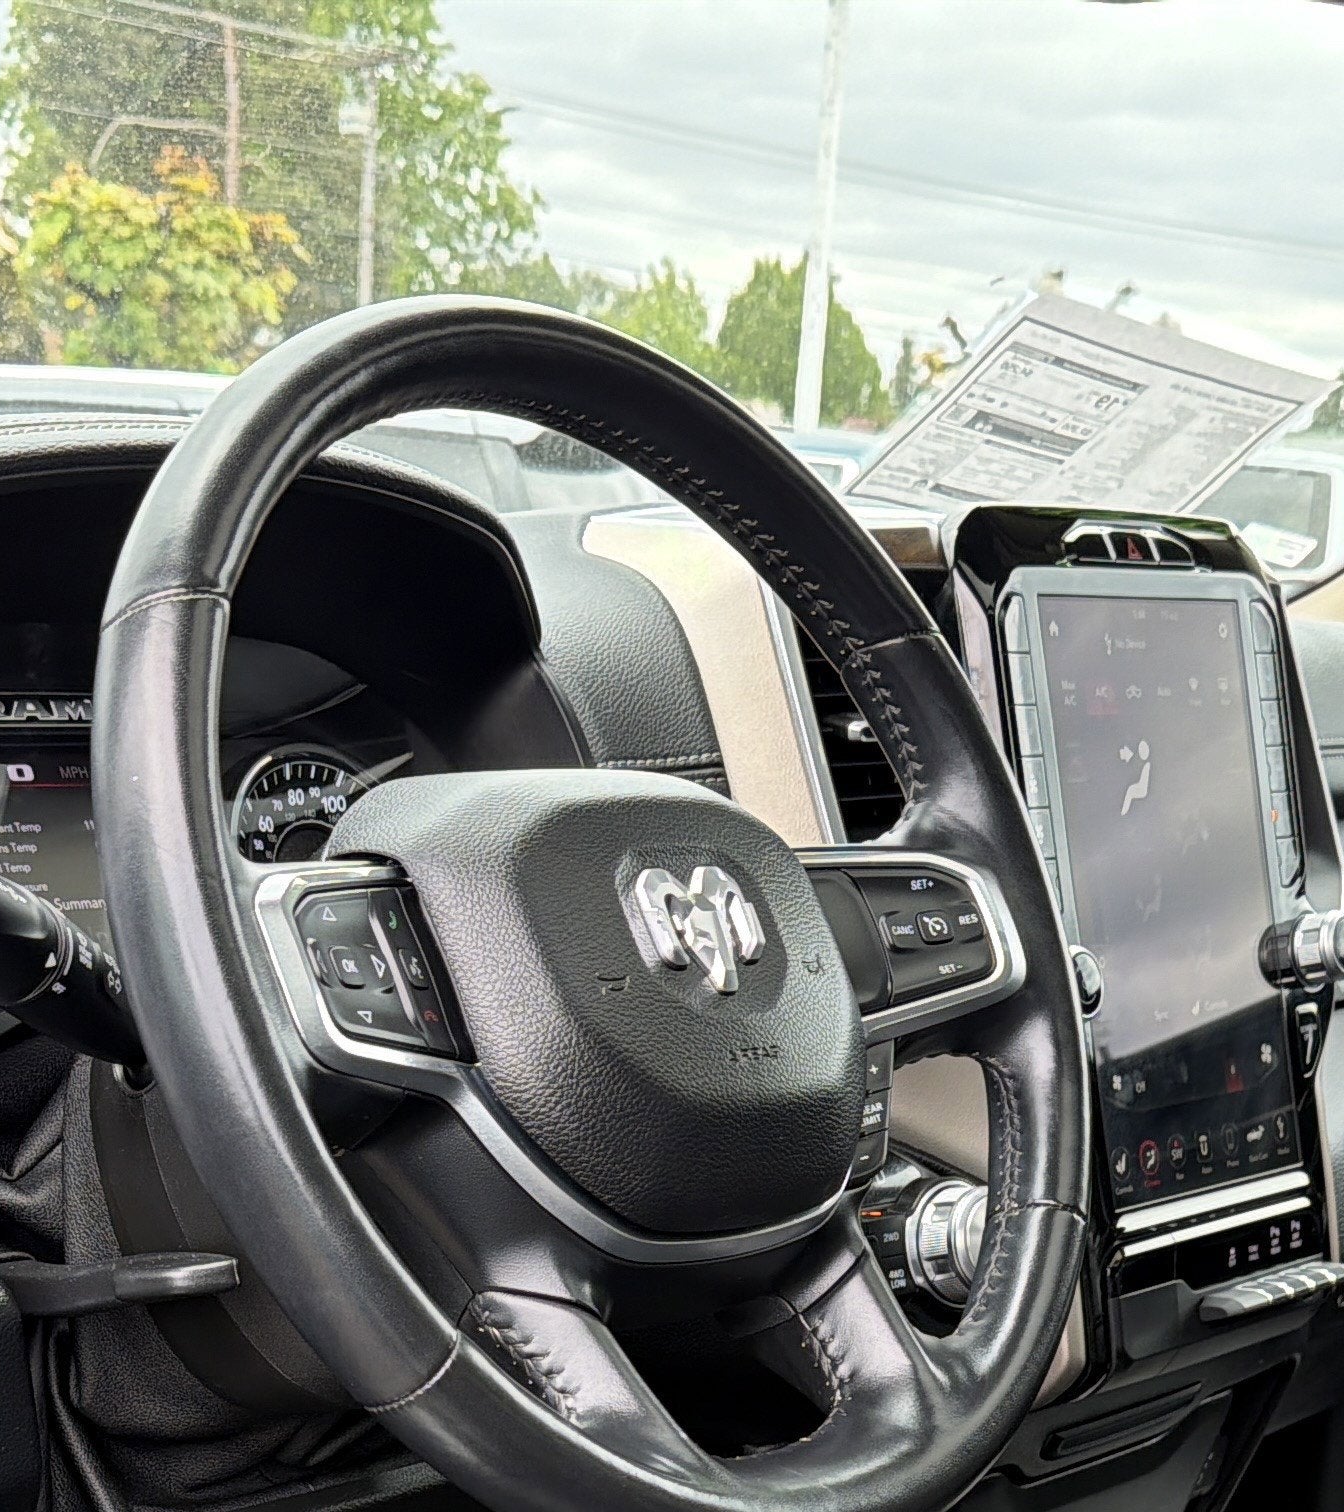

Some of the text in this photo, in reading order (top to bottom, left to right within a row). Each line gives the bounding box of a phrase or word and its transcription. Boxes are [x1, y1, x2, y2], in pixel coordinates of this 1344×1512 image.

[59, 766, 89, 779] MPH
[287, 788, 305, 806] 80
[309, 787, 321, 798] 90
[272, 800, 283, 811] 70
[321, 795, 347, 814] 100
[16, 823, 42, 836] Temp
[258, 815, 274, 833] 60
[11, 843, 37, 856] Temp
[3, 862, 32, 874] Temp
[959, 913, 979, 925] RES
[892, 924, 914, 935] CANC
[342, 958, 359, 973] OK
[863, 1102, 884, 1117] EAR
[861, 1113, 882, 1128] IMIT
